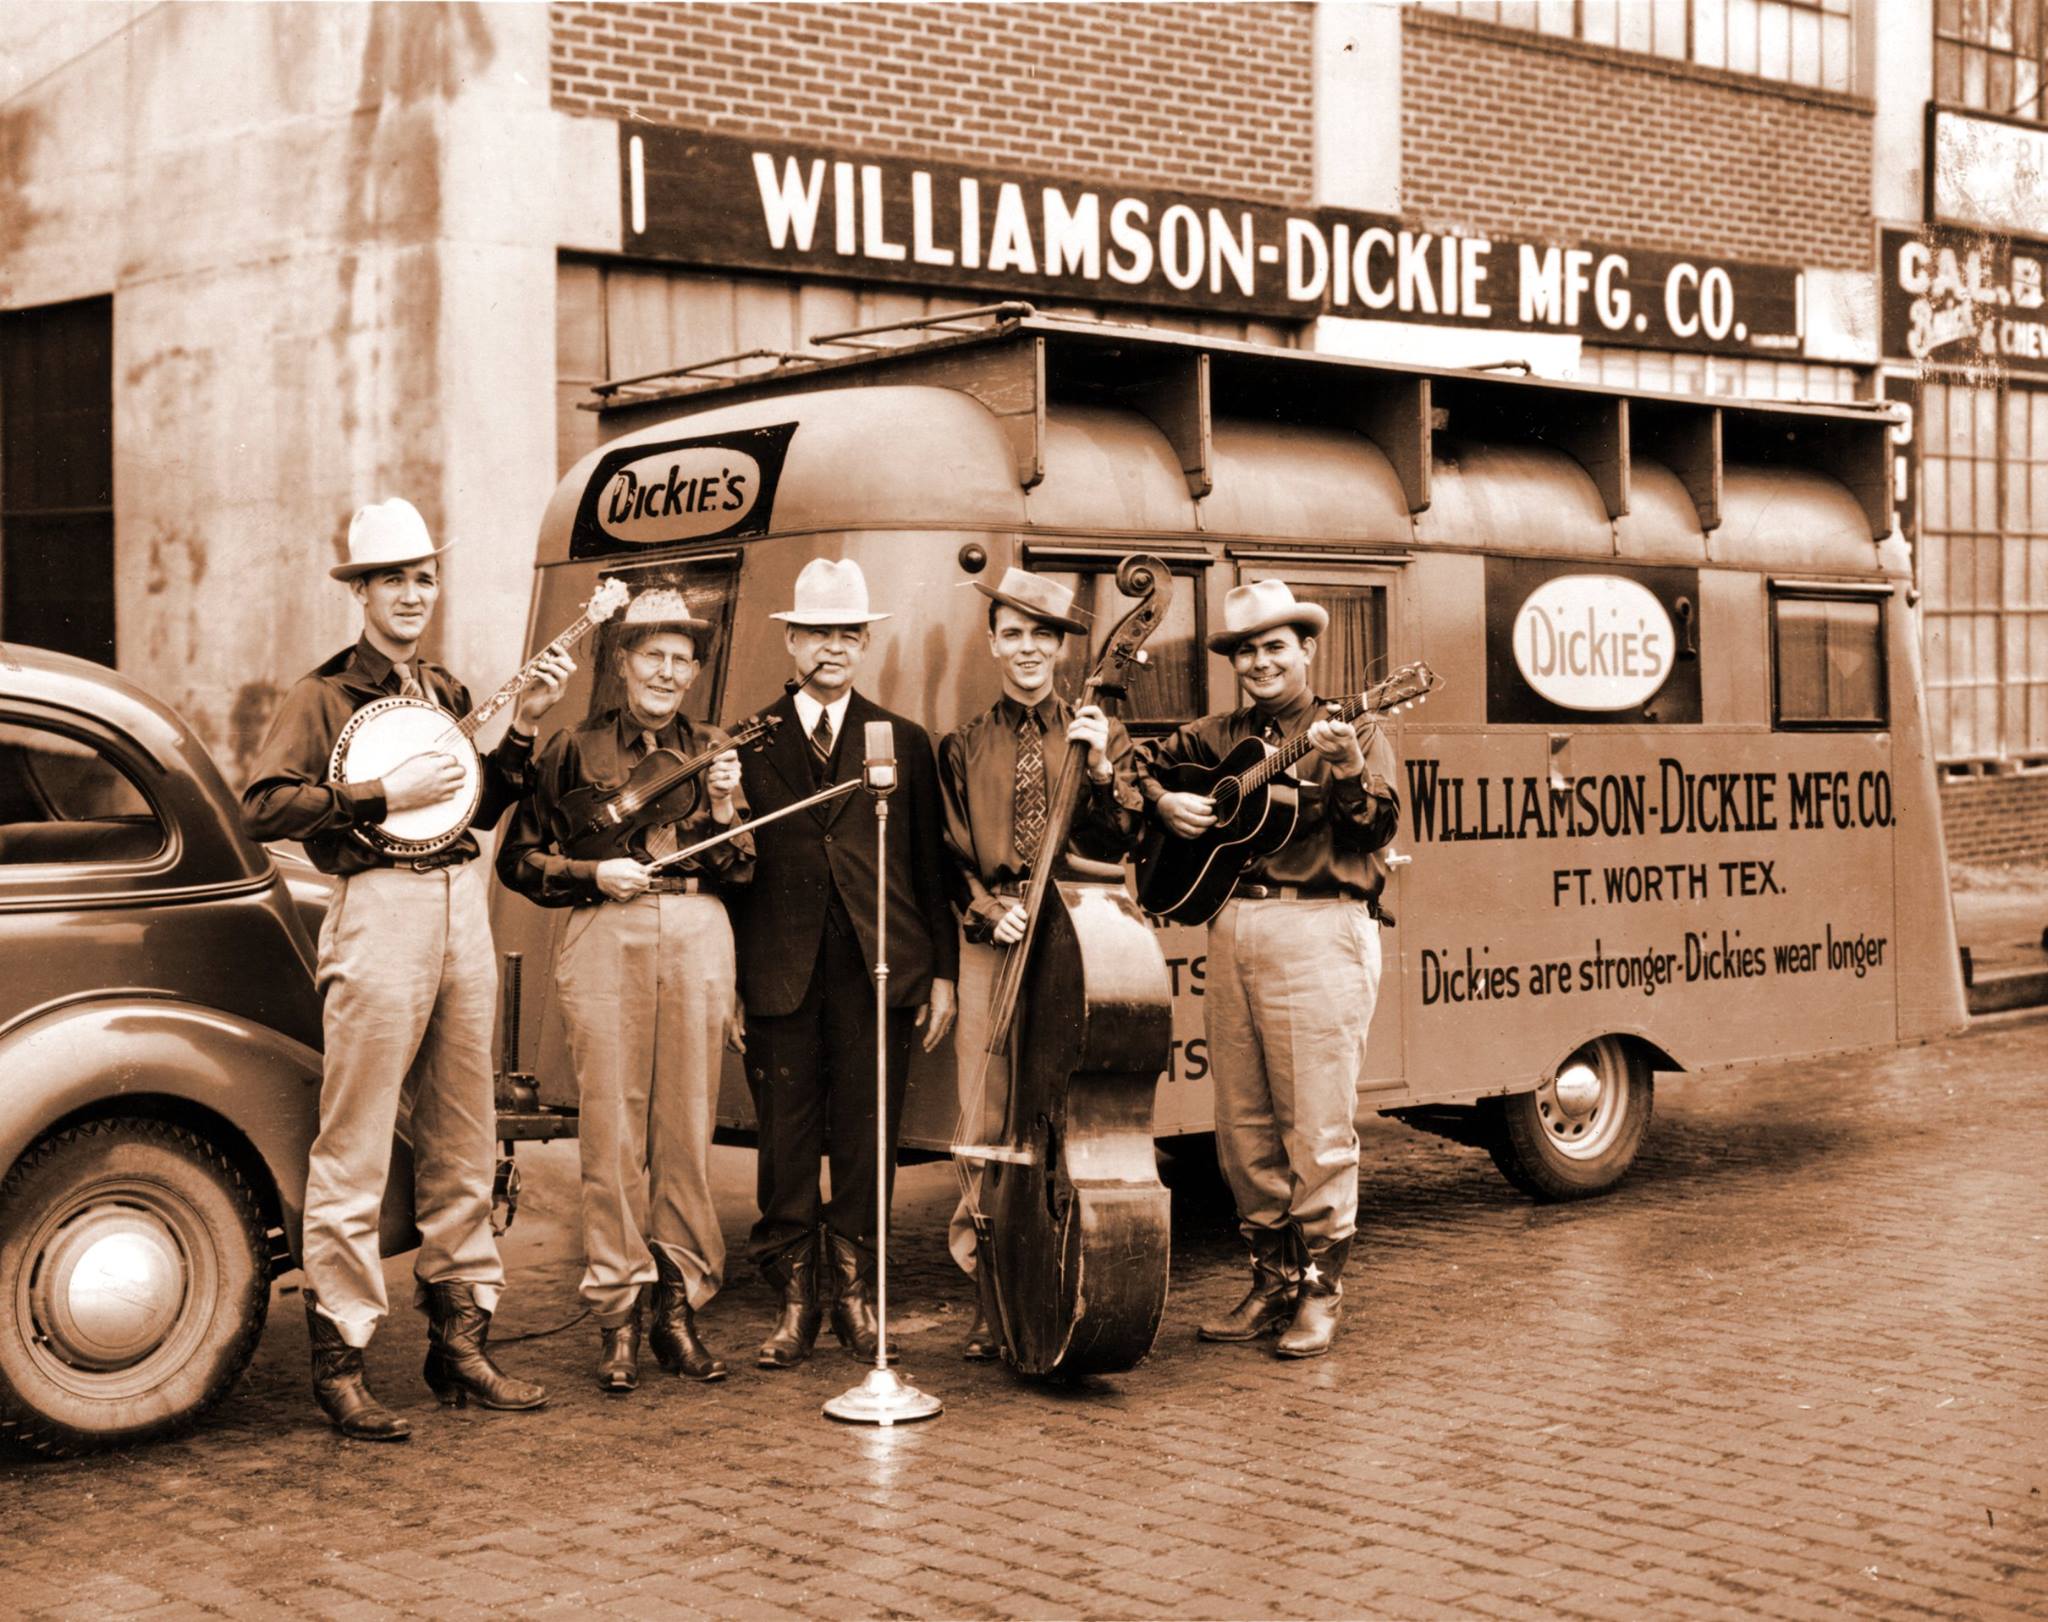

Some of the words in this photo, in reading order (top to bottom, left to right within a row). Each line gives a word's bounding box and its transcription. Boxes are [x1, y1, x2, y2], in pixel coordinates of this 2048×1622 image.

[752, 153, 1491, 317] WILLIAMSON-DICKIE
[1519, 244, 1647, 332] MFG.
[1665, 263, 1747, 341] CO.
[1554, 869, 1596, 906] FT.
[1604, 864, 1706, 903] WORTH
[1719, 860, 1786, 897] TEX.
[1421, 946, 1519, 1005] Dickies
[1529, 962, 1571, 995] are
[1773, 943, 1821, 974] wear
[1827, 923, 1887, 979] longer
